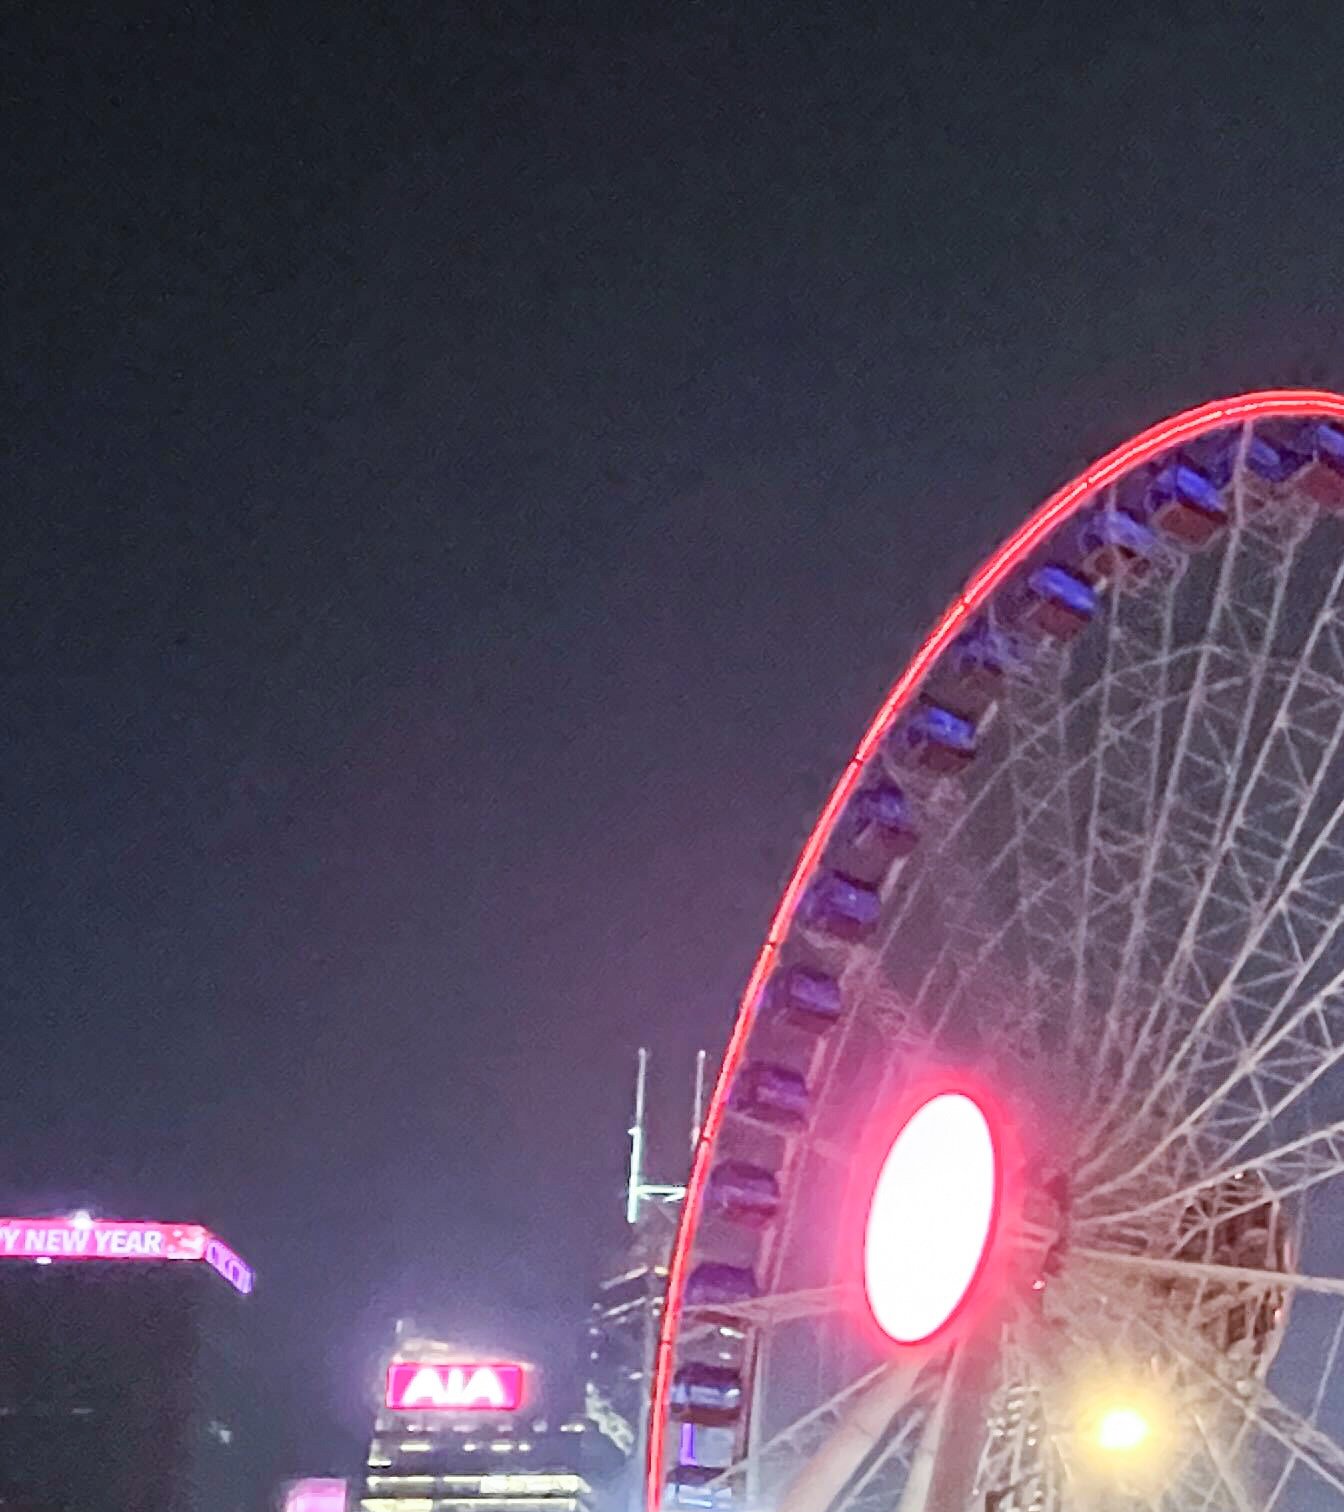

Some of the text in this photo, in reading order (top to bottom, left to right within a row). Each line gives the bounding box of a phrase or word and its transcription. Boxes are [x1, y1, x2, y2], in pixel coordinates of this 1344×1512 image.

[24, 1228, 90, 1252] NEW
[94, 1230, 162, 1255] YEAR
[402, 1367, 504, 1406] AIA
